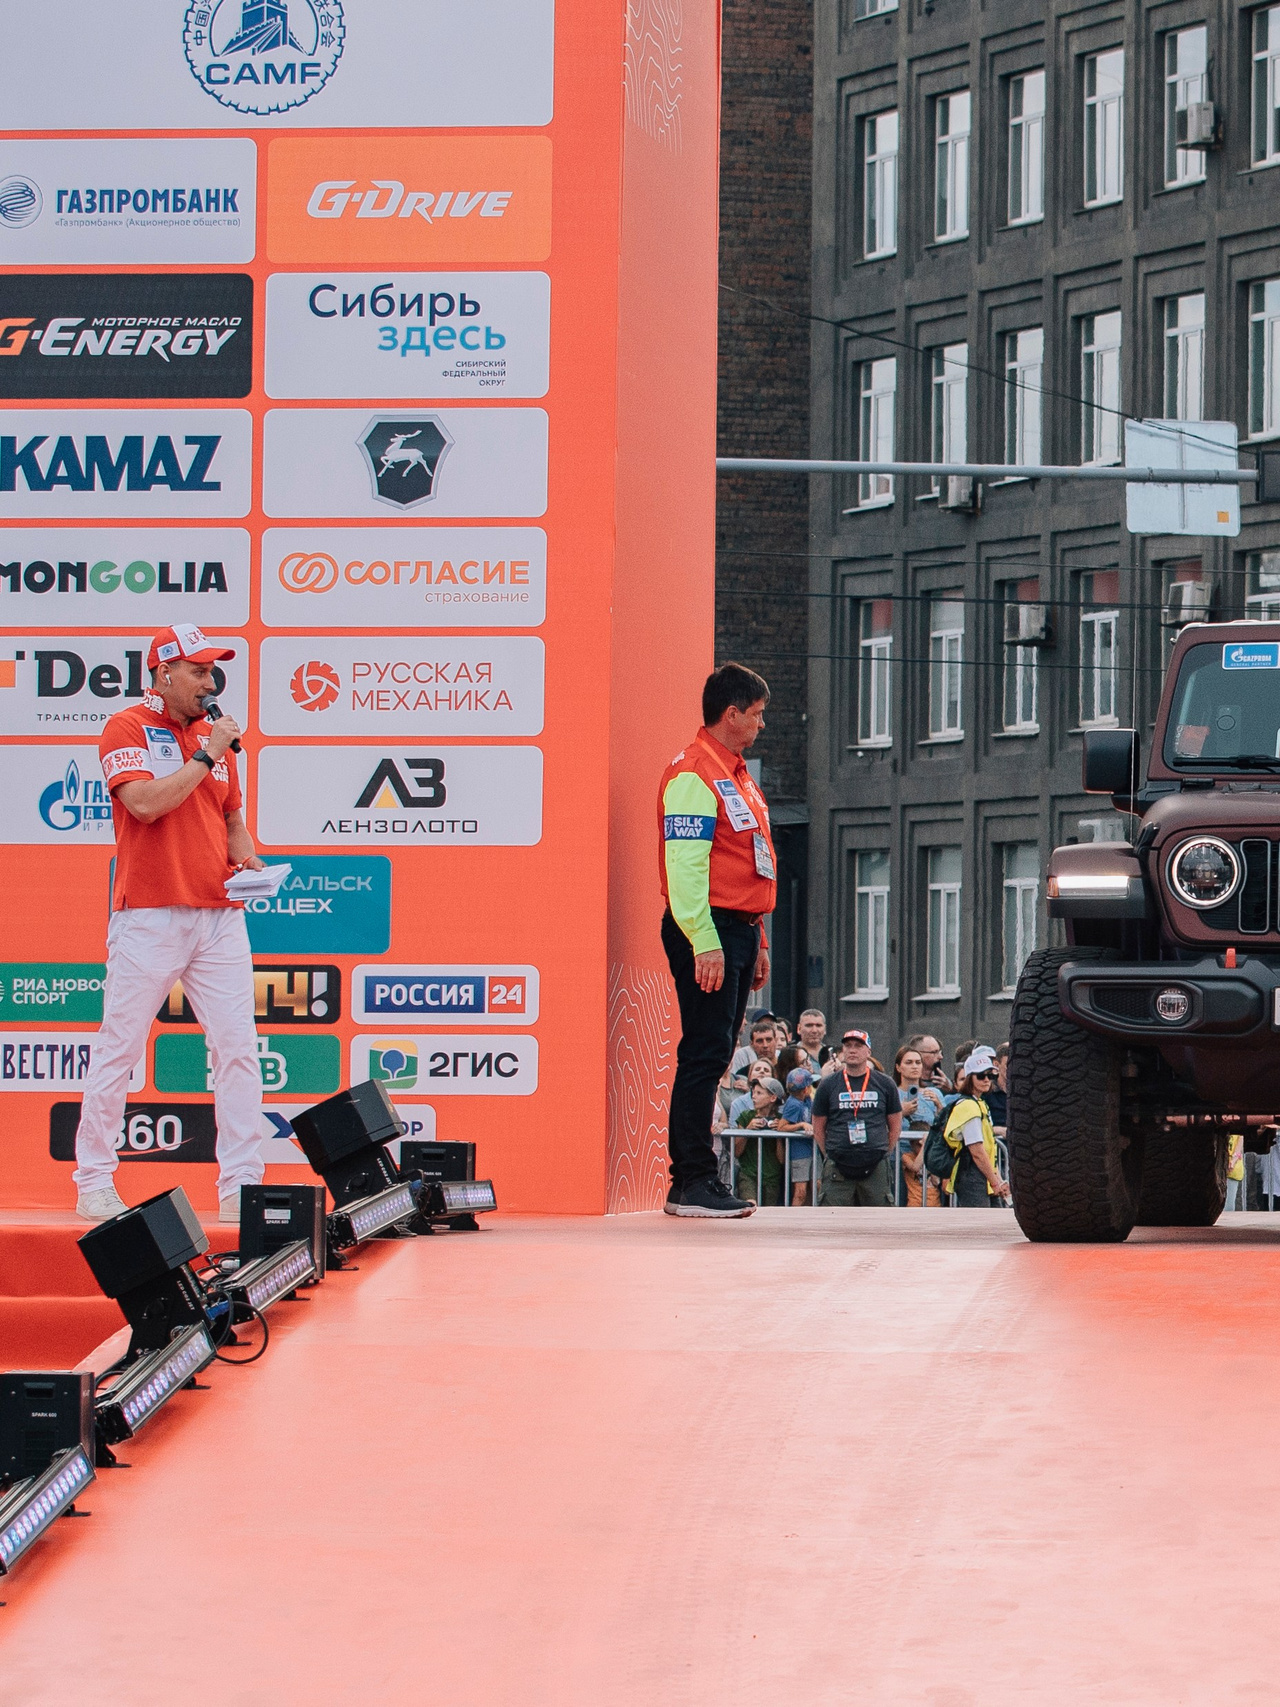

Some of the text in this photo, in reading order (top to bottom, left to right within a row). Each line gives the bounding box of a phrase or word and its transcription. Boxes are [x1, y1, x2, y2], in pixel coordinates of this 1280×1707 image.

[205, 62, 321, 85] CAMF
[56, 188, 239, 214] ГАЗПРОМБАНК
[55, 218, 241, 228] «Газпромбанк» (Акционерное общество)
[309, 283, 481, 327] Сибирь
[92, 317, 242, 327] МОТОРНОЕ МАСЛО
[377, 326, 506, 358] здесь
[455, 359, 506, 368] СИБИРСКИЙ
[442, 369, 506, 378] ФЕДЕРАЛЬНЫЙ
[478, 379, 506, 387] ОКРУГ
[0, 435, 222, 492] KAMAZ
[344, 560, 530, 585] СОГЛАСИЕ
[424, 591, 530, 605] страхование
[351, 662, 492, 684] РУССКАЯ
[351, 690, 514, 711] МЕХАНИКА
[37, 713, 113, 722] ТРАНСПОР
[114, 751, 142, 762] SILK
[115, 759, 144, 770] WAY
[322, 820, 478, 834] ЛЕНЗОЛОТО
[674, 817, 704, 828] SILK
[674, 826, 704, 838] WAY
[13, 978, 48, 991] РИА
[12, 992, 69, 1005] СПОРТ
[374, 984, 522, 1006] РОССИЯ 24
[429, 1051, 520, 1078] 2ГИС
[838, 1101, 879, 1109] SECURITY
